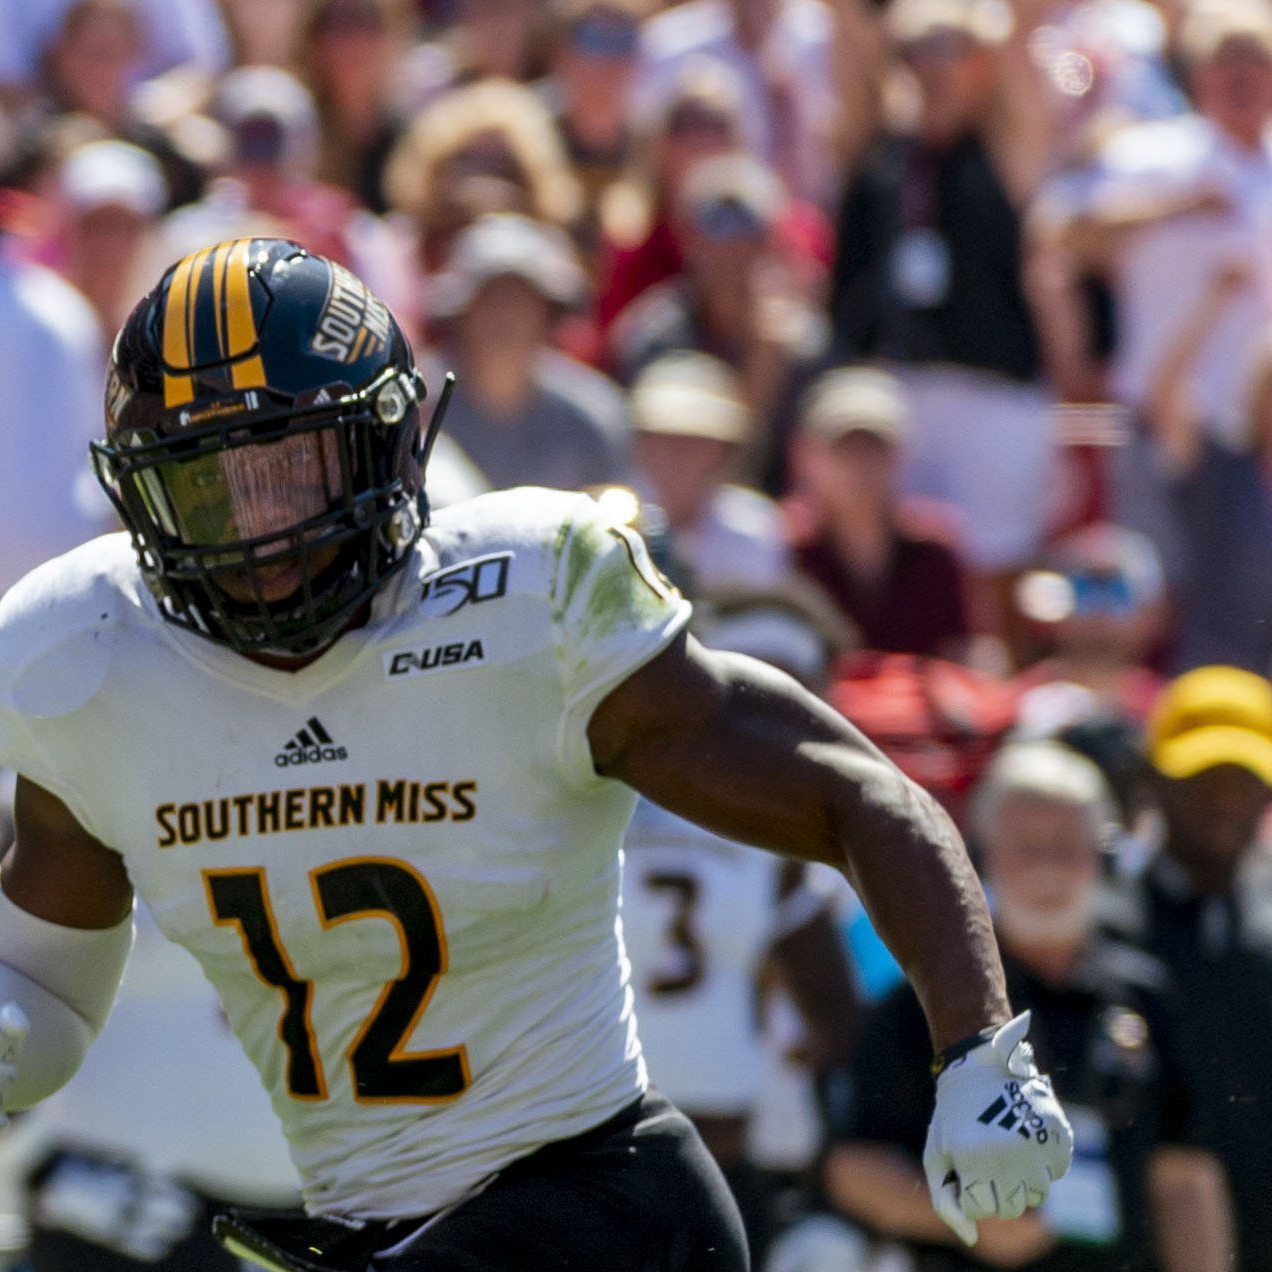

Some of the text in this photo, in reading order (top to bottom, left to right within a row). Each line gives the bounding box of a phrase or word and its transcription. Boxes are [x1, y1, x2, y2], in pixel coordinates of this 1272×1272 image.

[274, 744, 349, 768] adidas
[155, 779, 478, 848] SOUTHERN MISS
[200, 855, 472, 1105] 12
